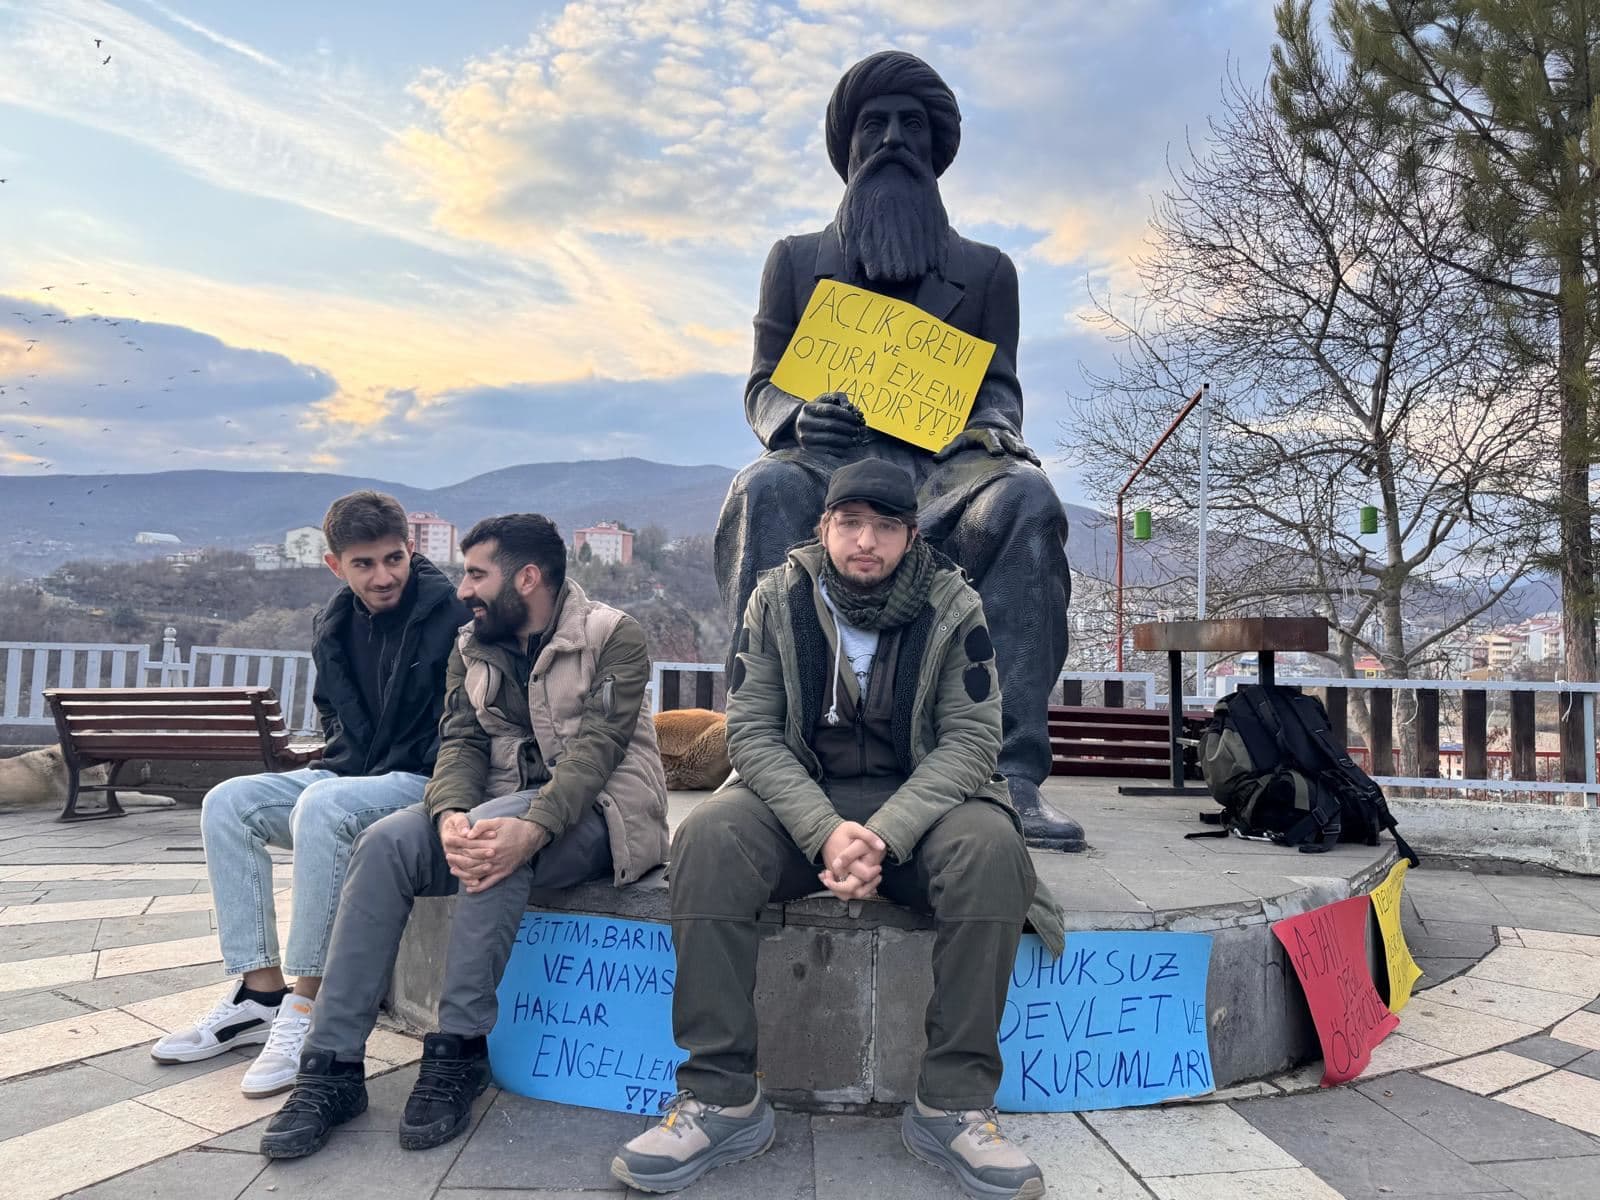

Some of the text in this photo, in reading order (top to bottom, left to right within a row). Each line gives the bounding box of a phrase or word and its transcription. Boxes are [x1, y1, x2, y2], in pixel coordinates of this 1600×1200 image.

[793, 336, 876, 375] OTURA
[544, 953, 575, 984] VE
[513, 992, 609, 1027] HAKLAR
[999, 994, 1204, 1043] DEVLET VE
[1021, 1048, 1210, 1101] KURUMLARI
